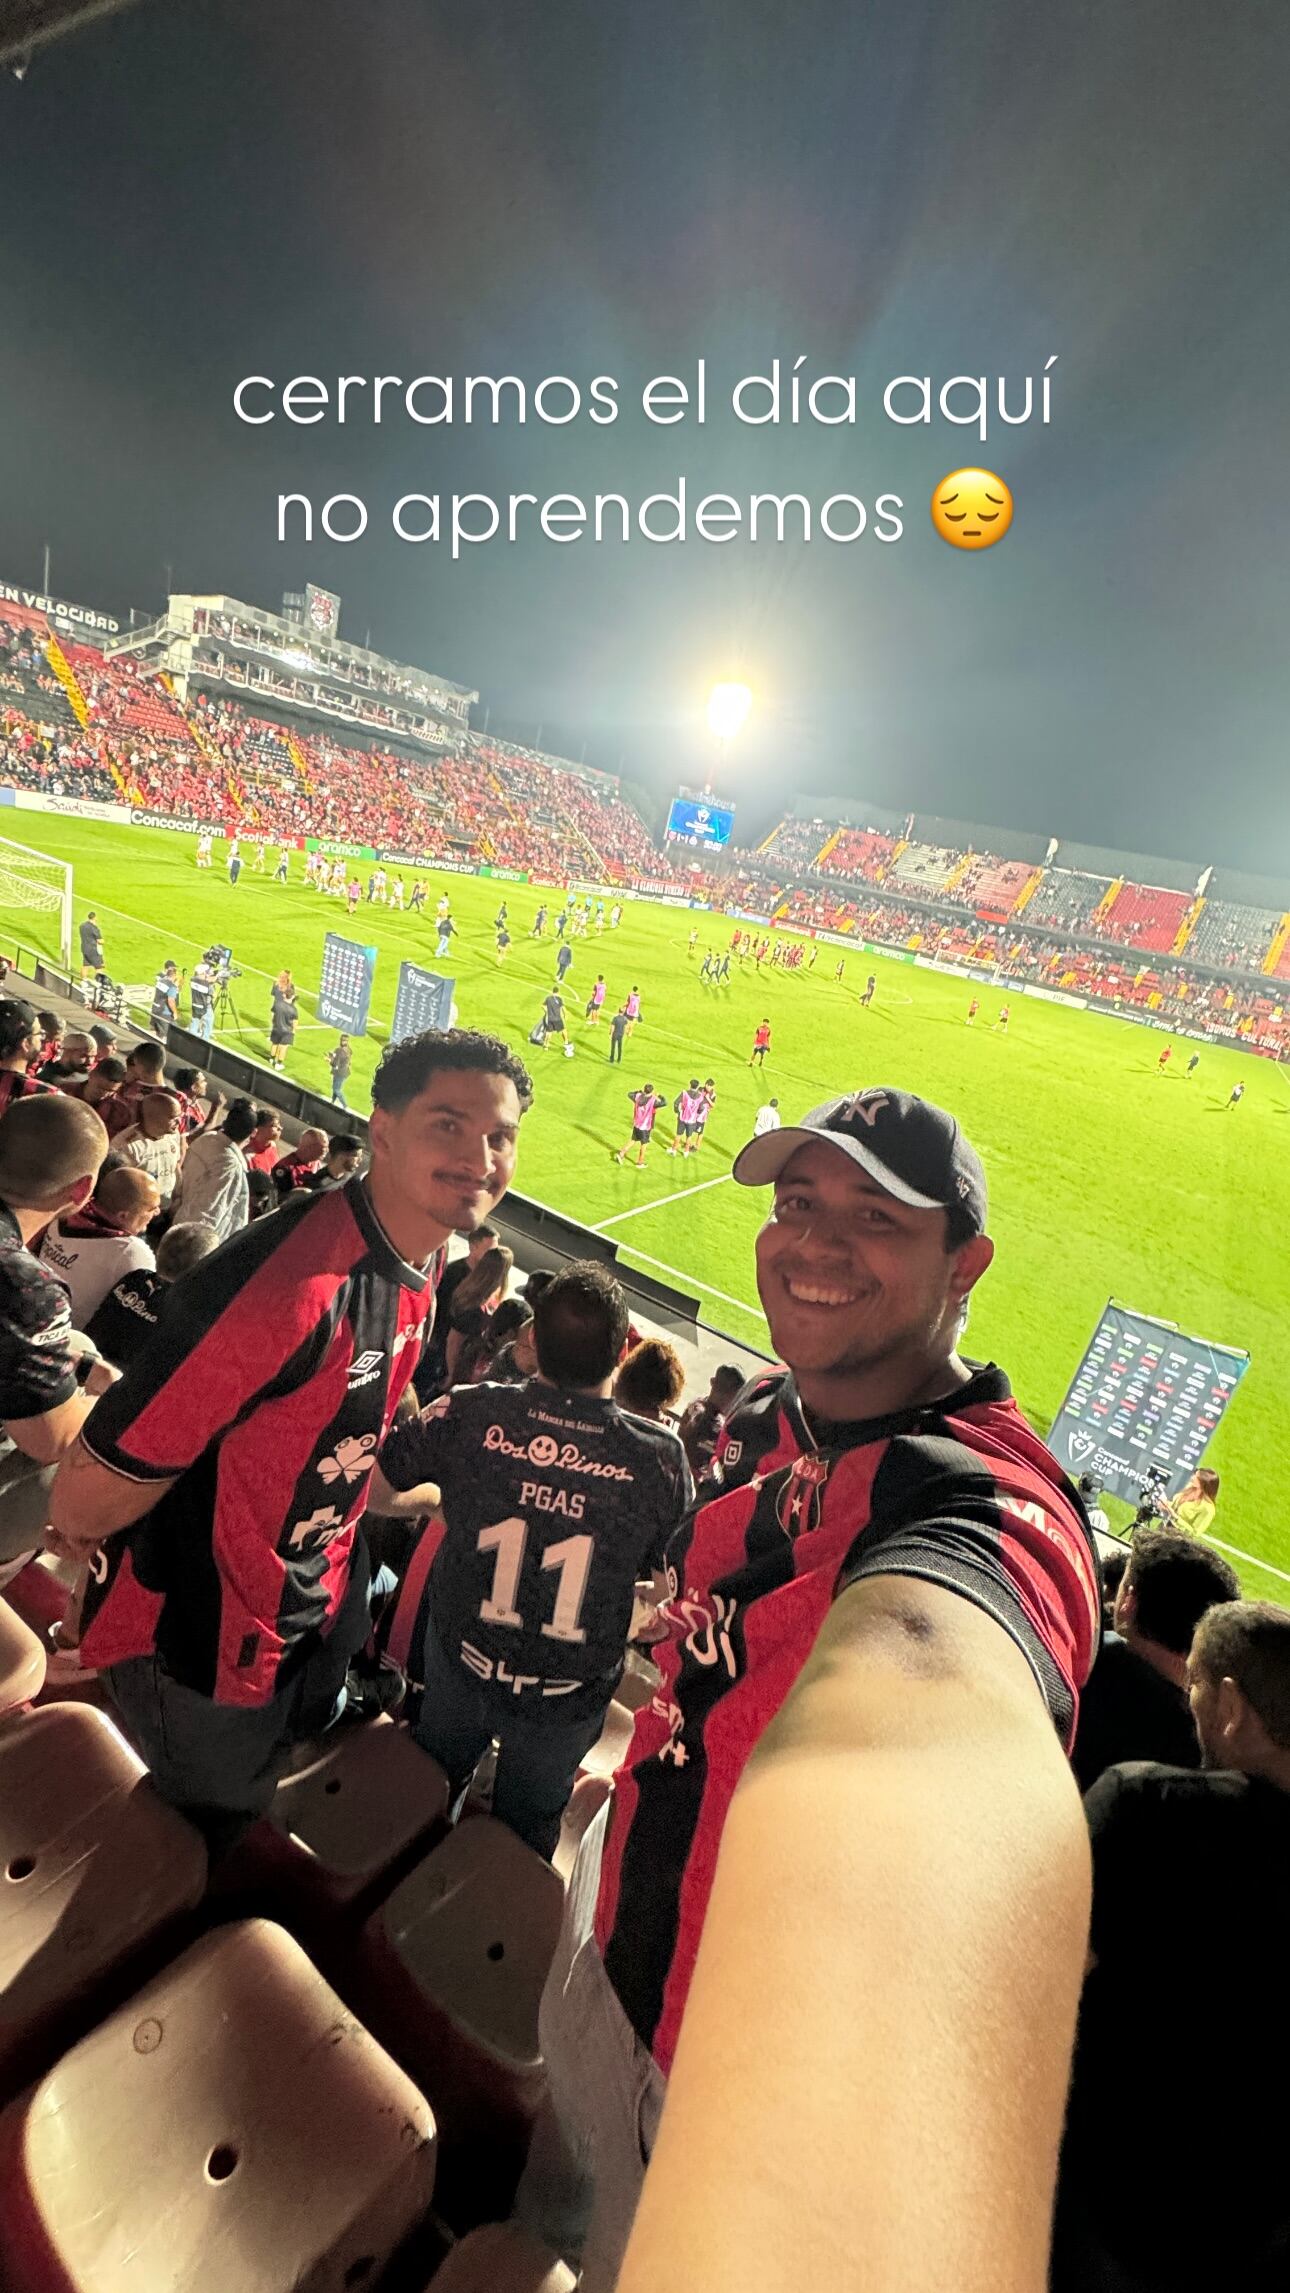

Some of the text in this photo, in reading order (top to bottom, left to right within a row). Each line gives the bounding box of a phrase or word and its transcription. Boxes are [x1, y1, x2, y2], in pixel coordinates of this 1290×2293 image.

[22, 592, 119, 633] VELOCIDAD
[132, 810, 226, 838] Concacaf.com
[318, 841, 361, 857] aramco
[415, 858, 459, 872] CHAMPIONS
[459, 863, 475, 874] CUP
[490, 869, 520, 881] aramco
[873, 945, 905, 961] aramco
[347, 1370, 381, 1389] umbro
[483, 1424, 634, 1482] Dos Pinos
[1090, 1461, 1114, 1476] CUP
[1094, 1453, 1161, 1490] CHAMPION
[518, 1481, 586, 1519] PGAS
[477, 1516, 595, 1644] 11
